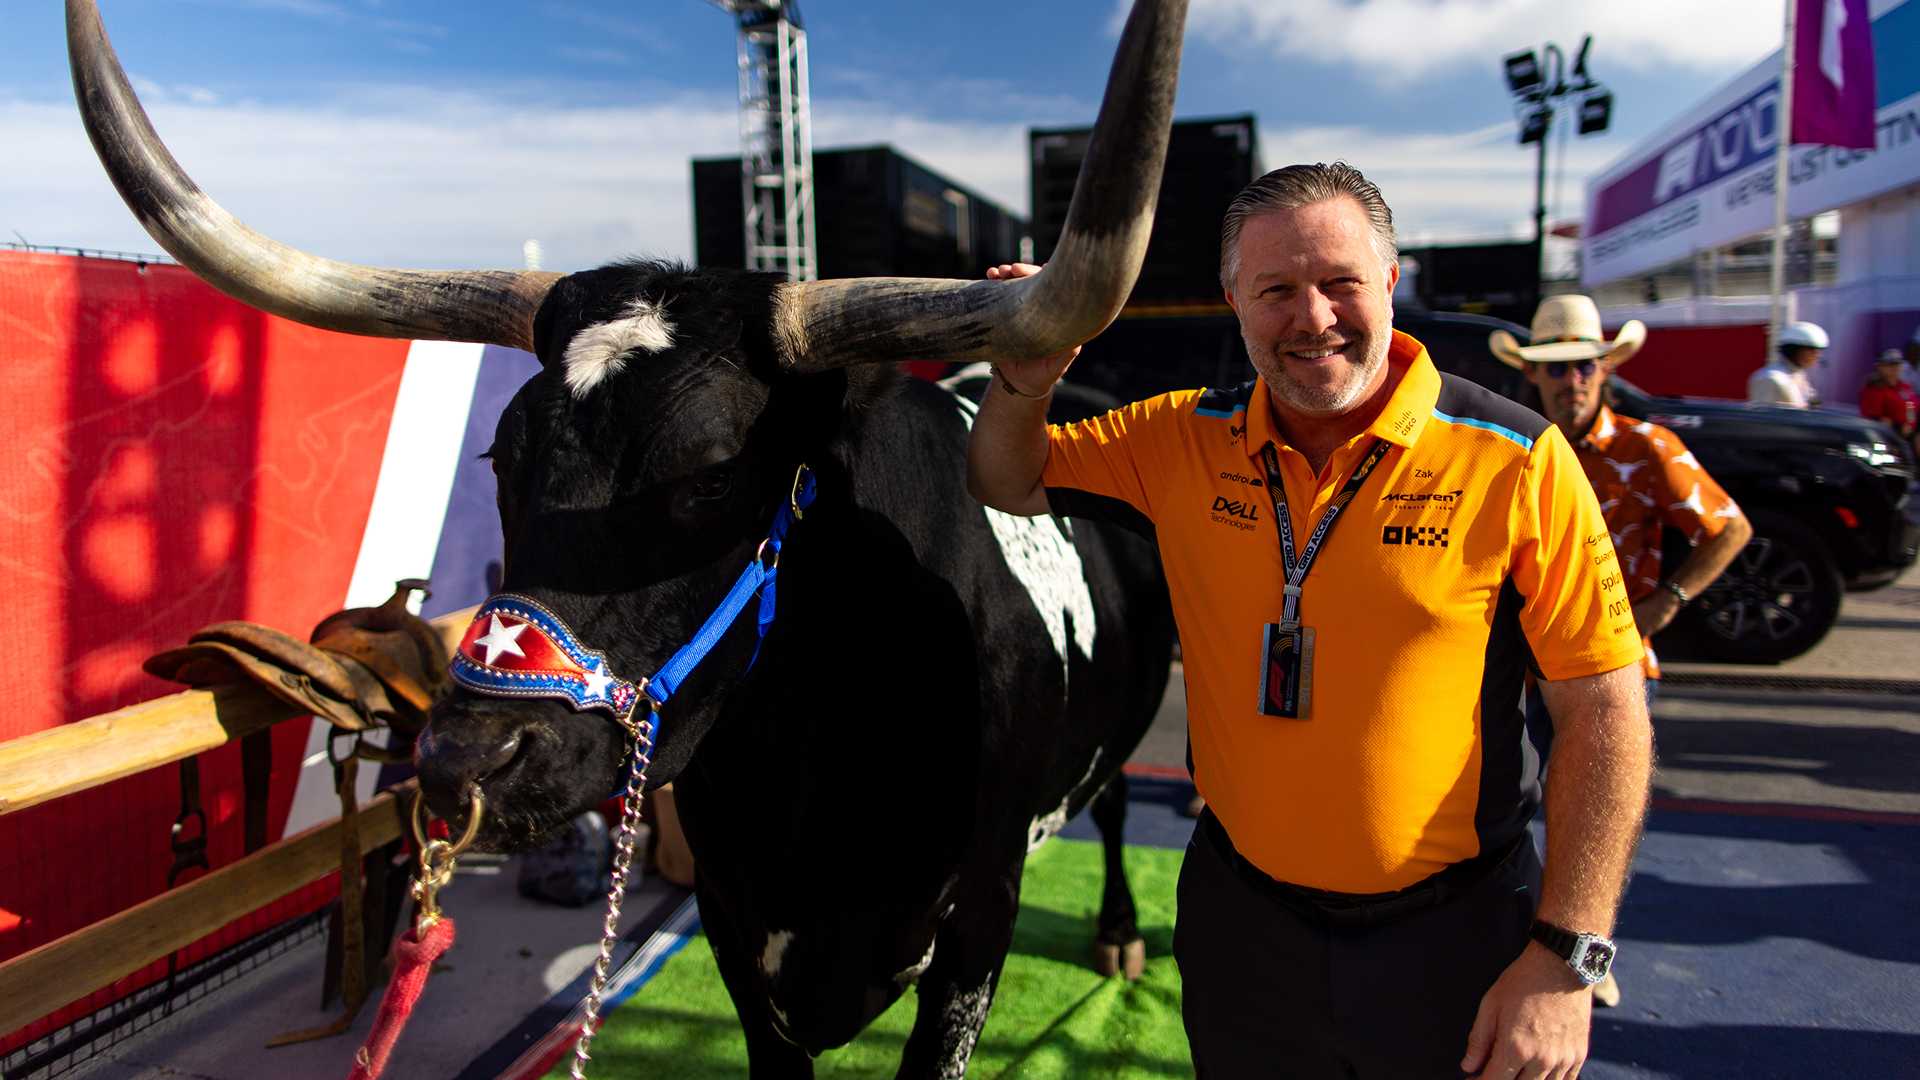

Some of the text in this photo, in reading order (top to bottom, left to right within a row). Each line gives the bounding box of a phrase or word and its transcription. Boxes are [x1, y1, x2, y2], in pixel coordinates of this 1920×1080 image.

[1414, 469, 1434, 479] Zak
[1212, 495, 1259, 521] DELL
[1381, 492, 1456, 502] McLaren
[1210, 512, 1256, 532] Technologies
[1279, 504, 1297, 570] GRID ACCESS
[1298, 507, 1338, 571] GRID ACCESS
[1382, 526, 1449, 548] OKX
[1300, 650, 1312, 704] PIT LANE
